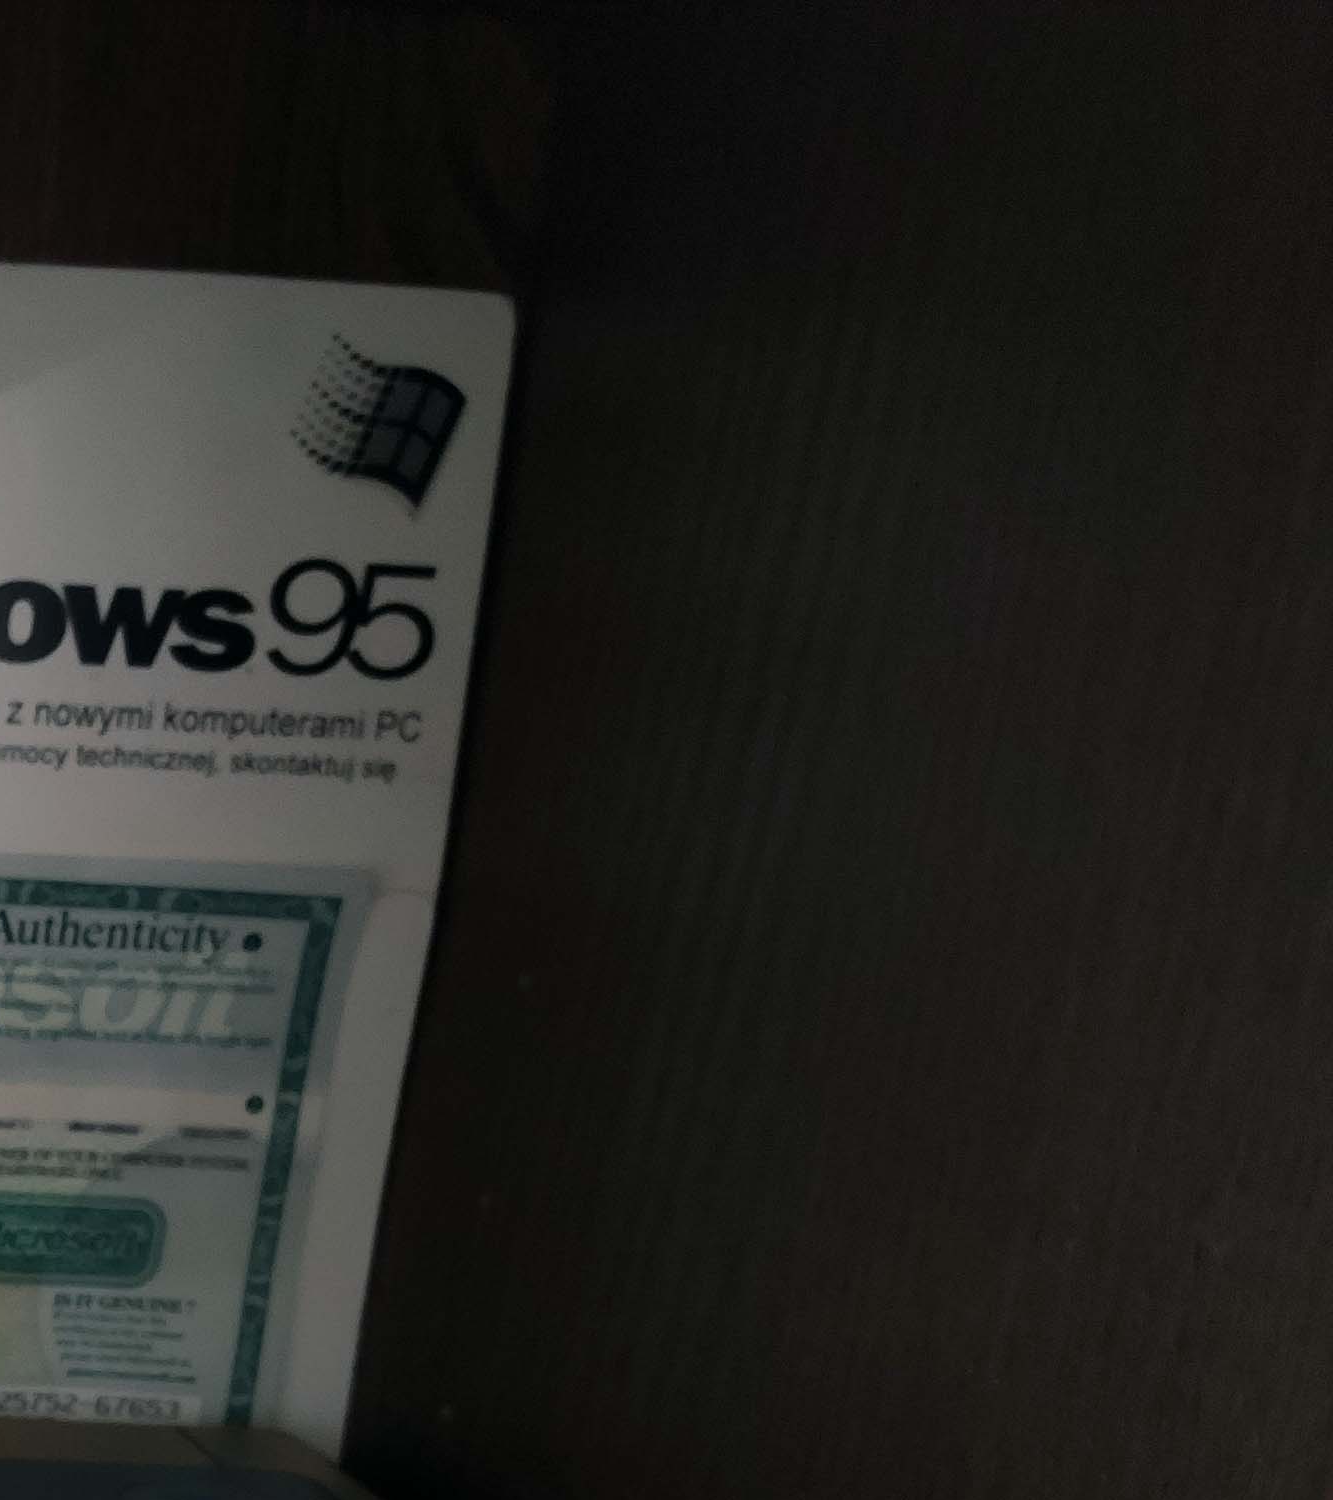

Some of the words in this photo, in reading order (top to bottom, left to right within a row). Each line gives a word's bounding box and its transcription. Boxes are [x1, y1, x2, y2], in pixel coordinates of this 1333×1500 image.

[266, 557, 437, 678] 95
[6, 702, 23, 727] z
[33, 702, 154, 736] nowymi
[164, 703, 364, 740] komputerami
[375, 709, 422, 743] PC
